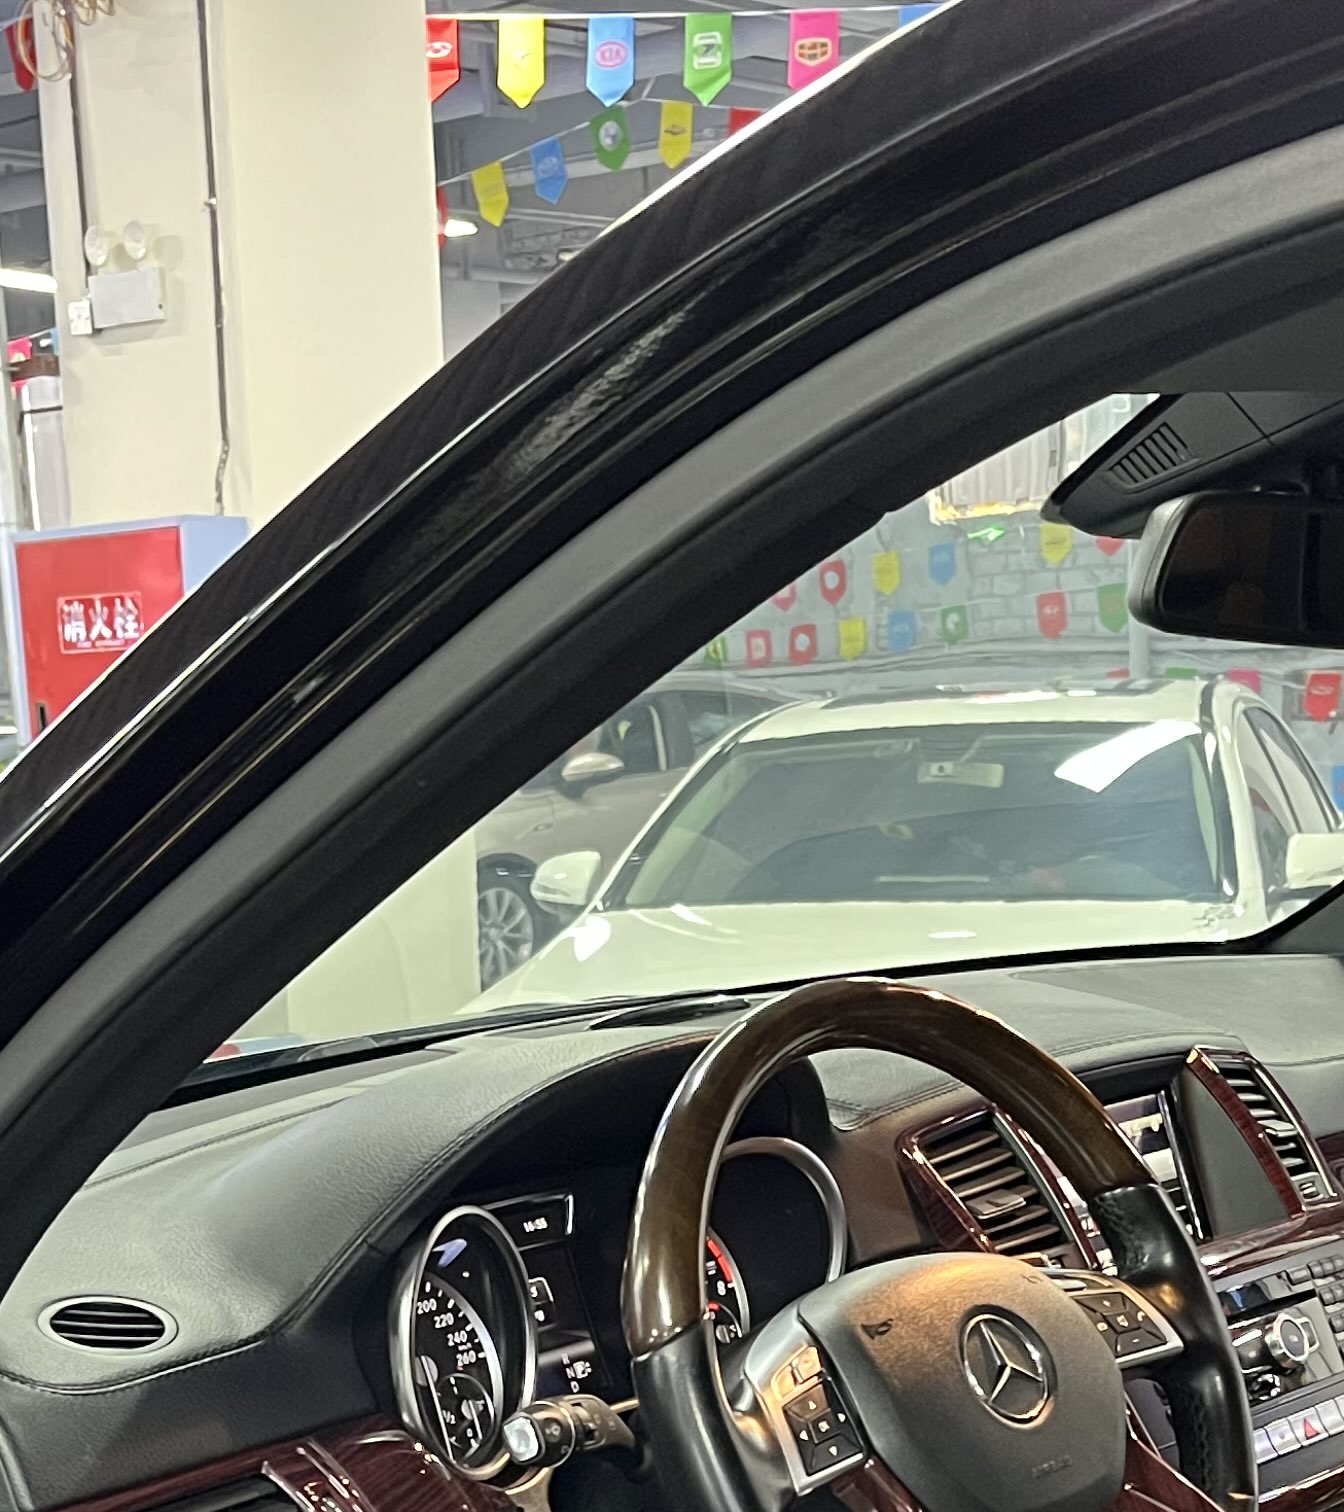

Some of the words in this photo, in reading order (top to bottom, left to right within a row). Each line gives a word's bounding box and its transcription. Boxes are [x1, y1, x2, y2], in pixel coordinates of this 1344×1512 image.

[62, 597, 140, 643] 消火栓
[716, 1280, 727, 1296] 8
[416, 1298, 437, 1316] 200
[433, 1311, 455, 1330] 220
[447, 1329, 468, 1347] 240
[456, 1350, 477, 1367] 260
[565, 1366, 576, 1379] N
